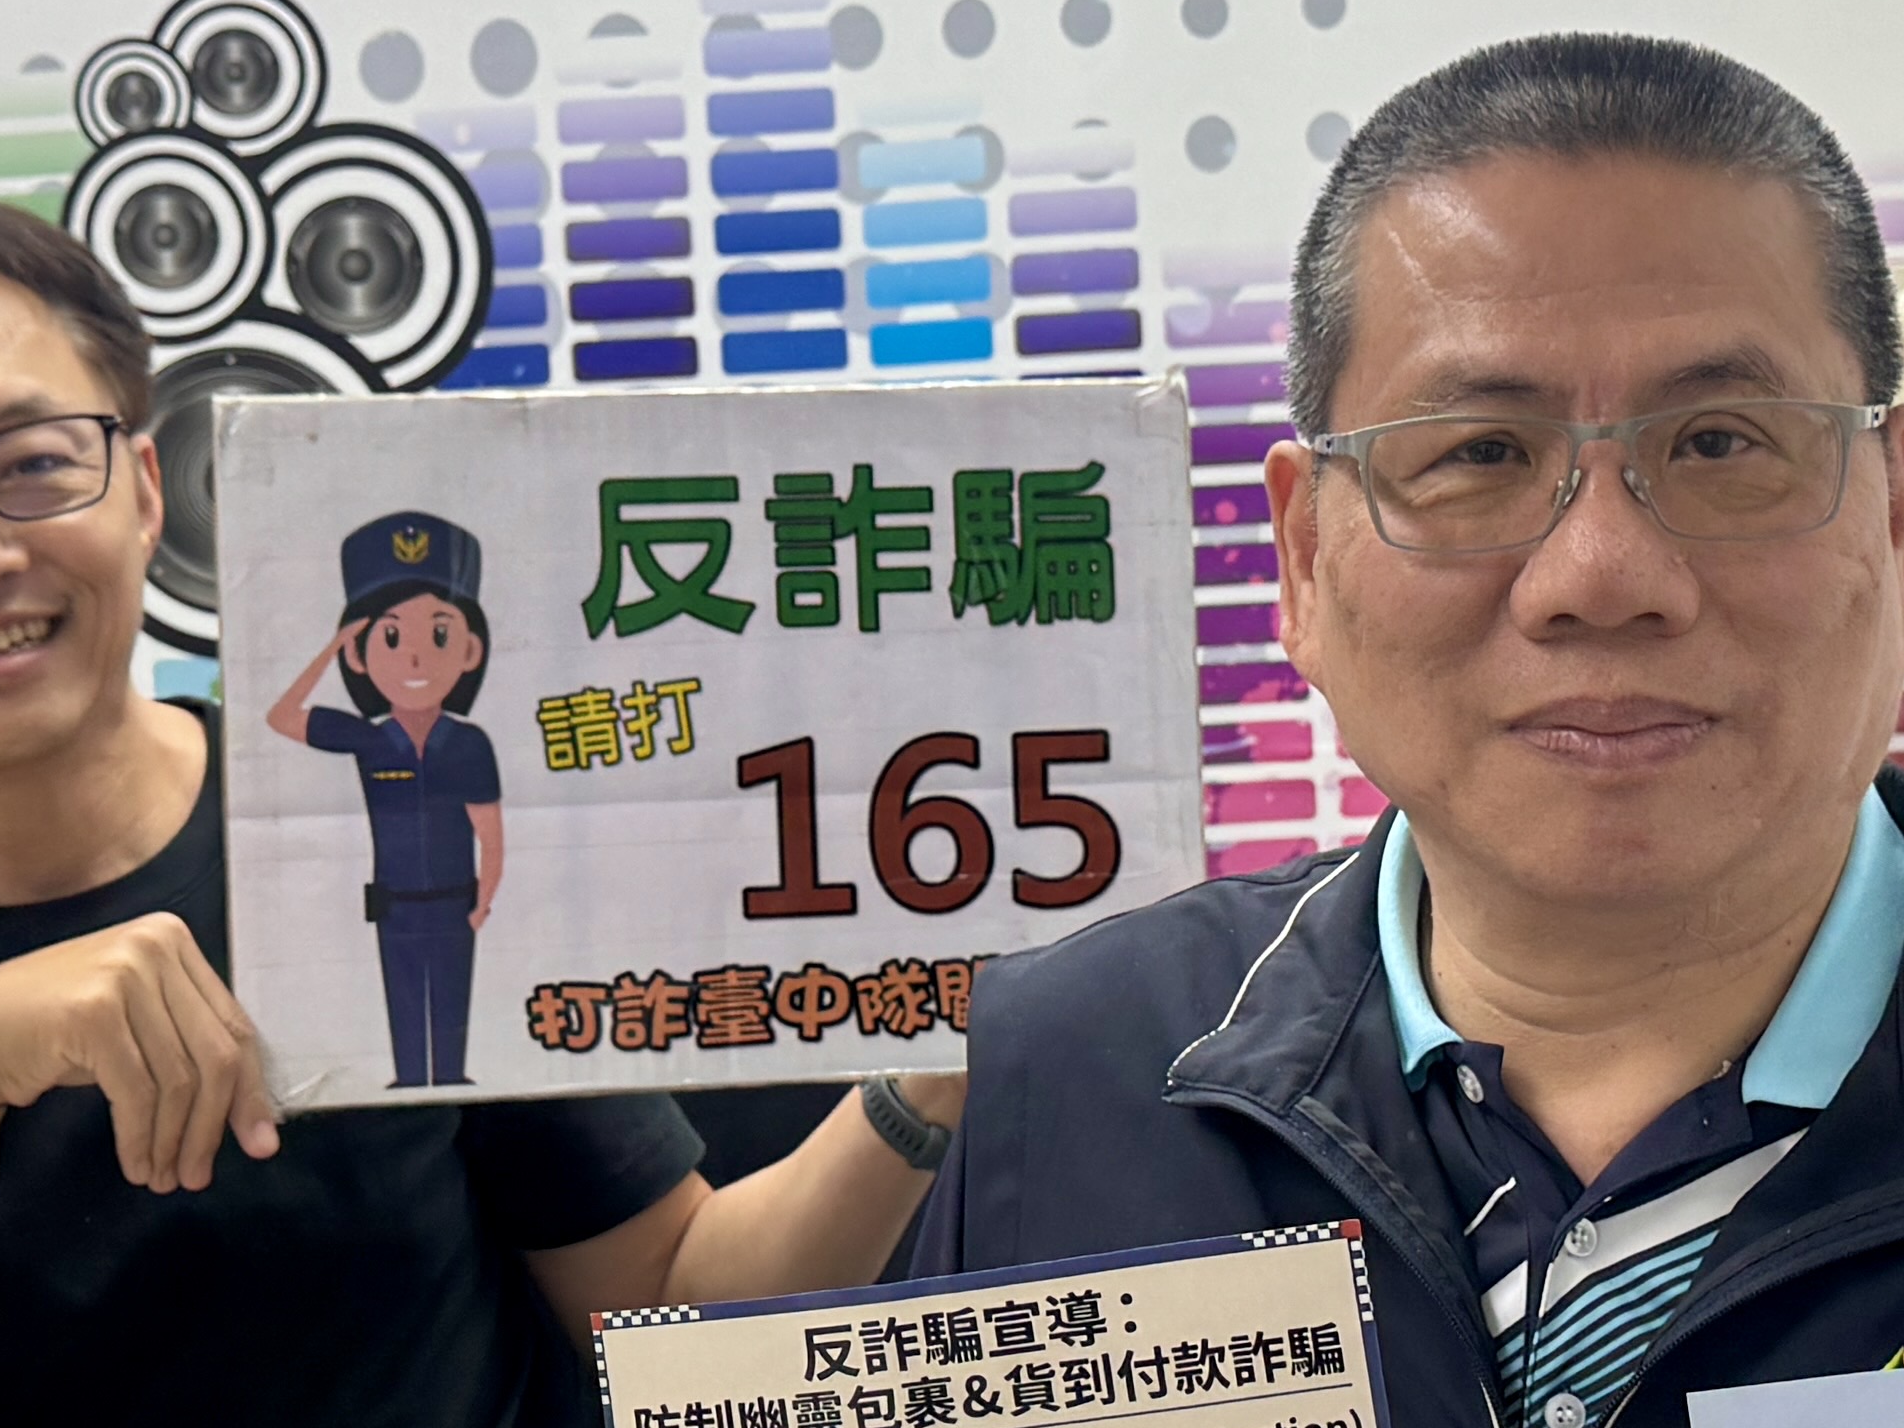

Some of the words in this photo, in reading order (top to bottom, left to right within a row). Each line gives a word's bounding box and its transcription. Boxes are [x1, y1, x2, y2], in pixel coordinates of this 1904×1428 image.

[582, 462, 1115, 638] 反詐騙
[537, 677, 701, 771] 請打
[736, 729, 1122, 920] 165
[803, 1290, 1138, 1380] 反詐騙宣導：
